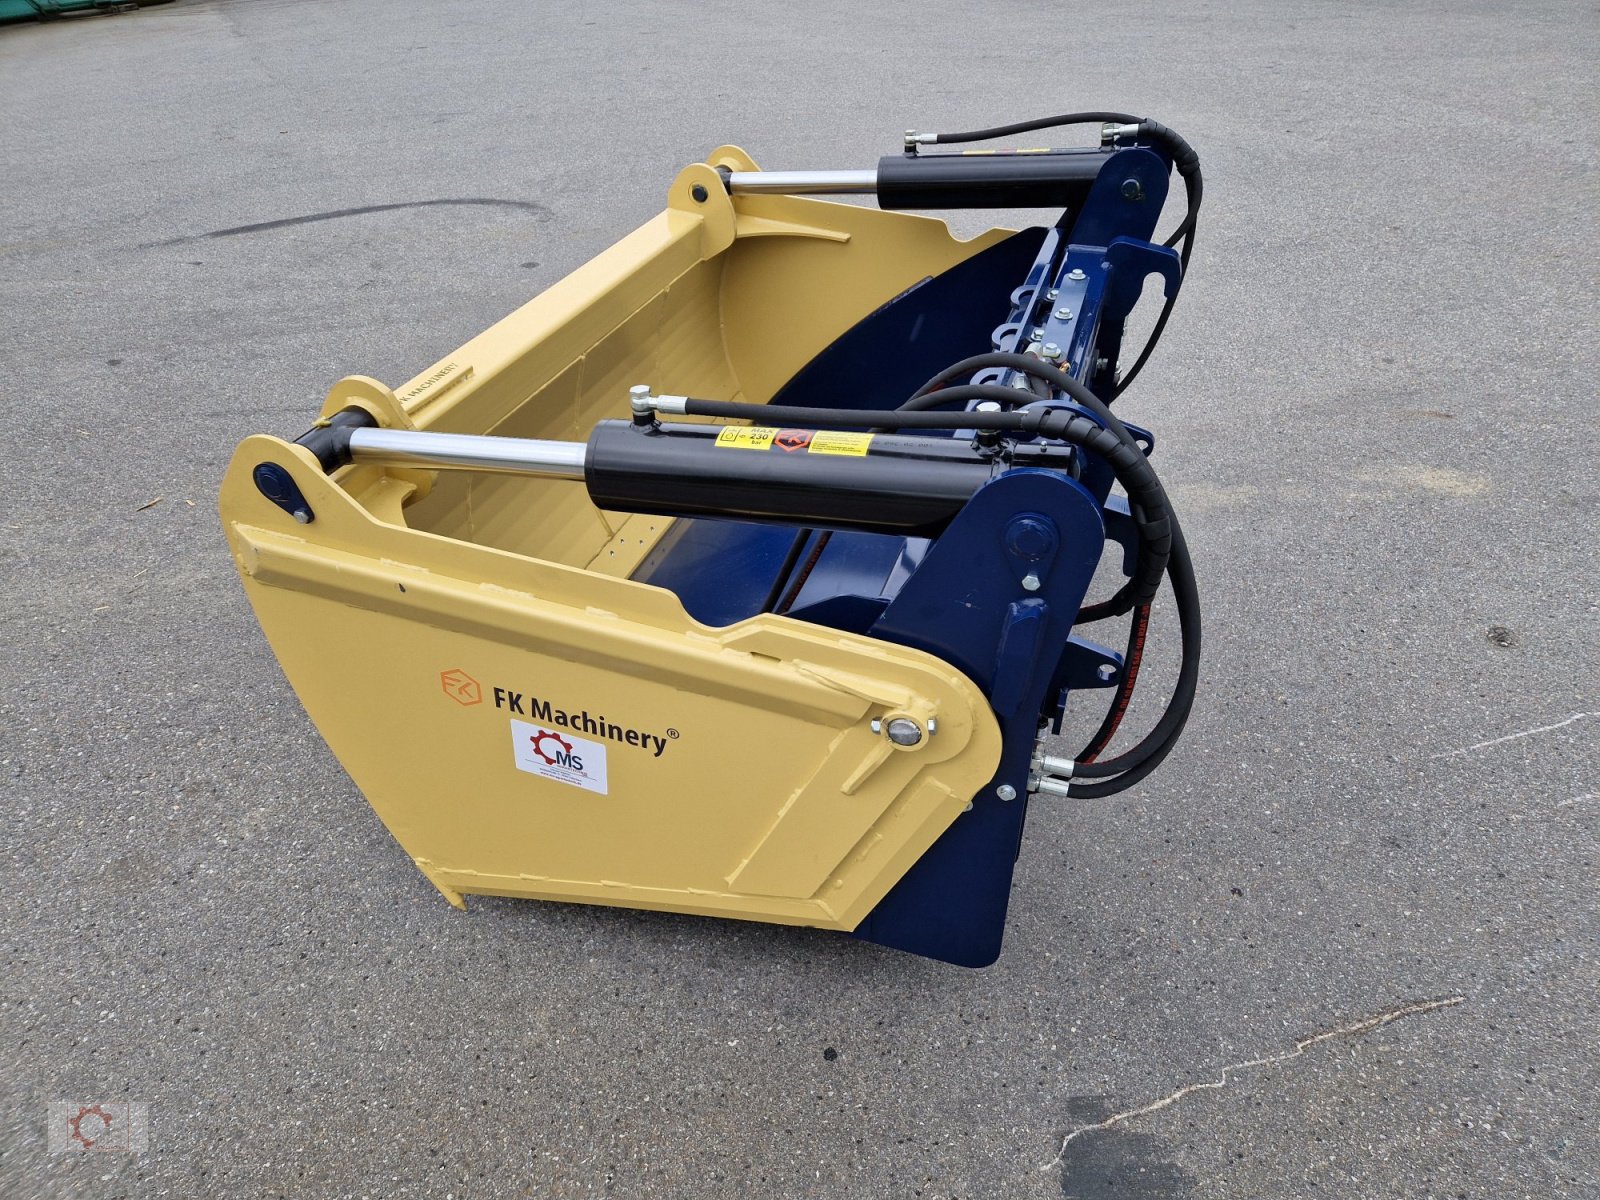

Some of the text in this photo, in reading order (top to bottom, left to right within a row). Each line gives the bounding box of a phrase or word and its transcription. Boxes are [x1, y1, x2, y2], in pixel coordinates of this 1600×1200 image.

[408, 362, 459, 398] MACHINERY
[493, 687, 524, 715] FK
[556, 750, 584, 771] MS
